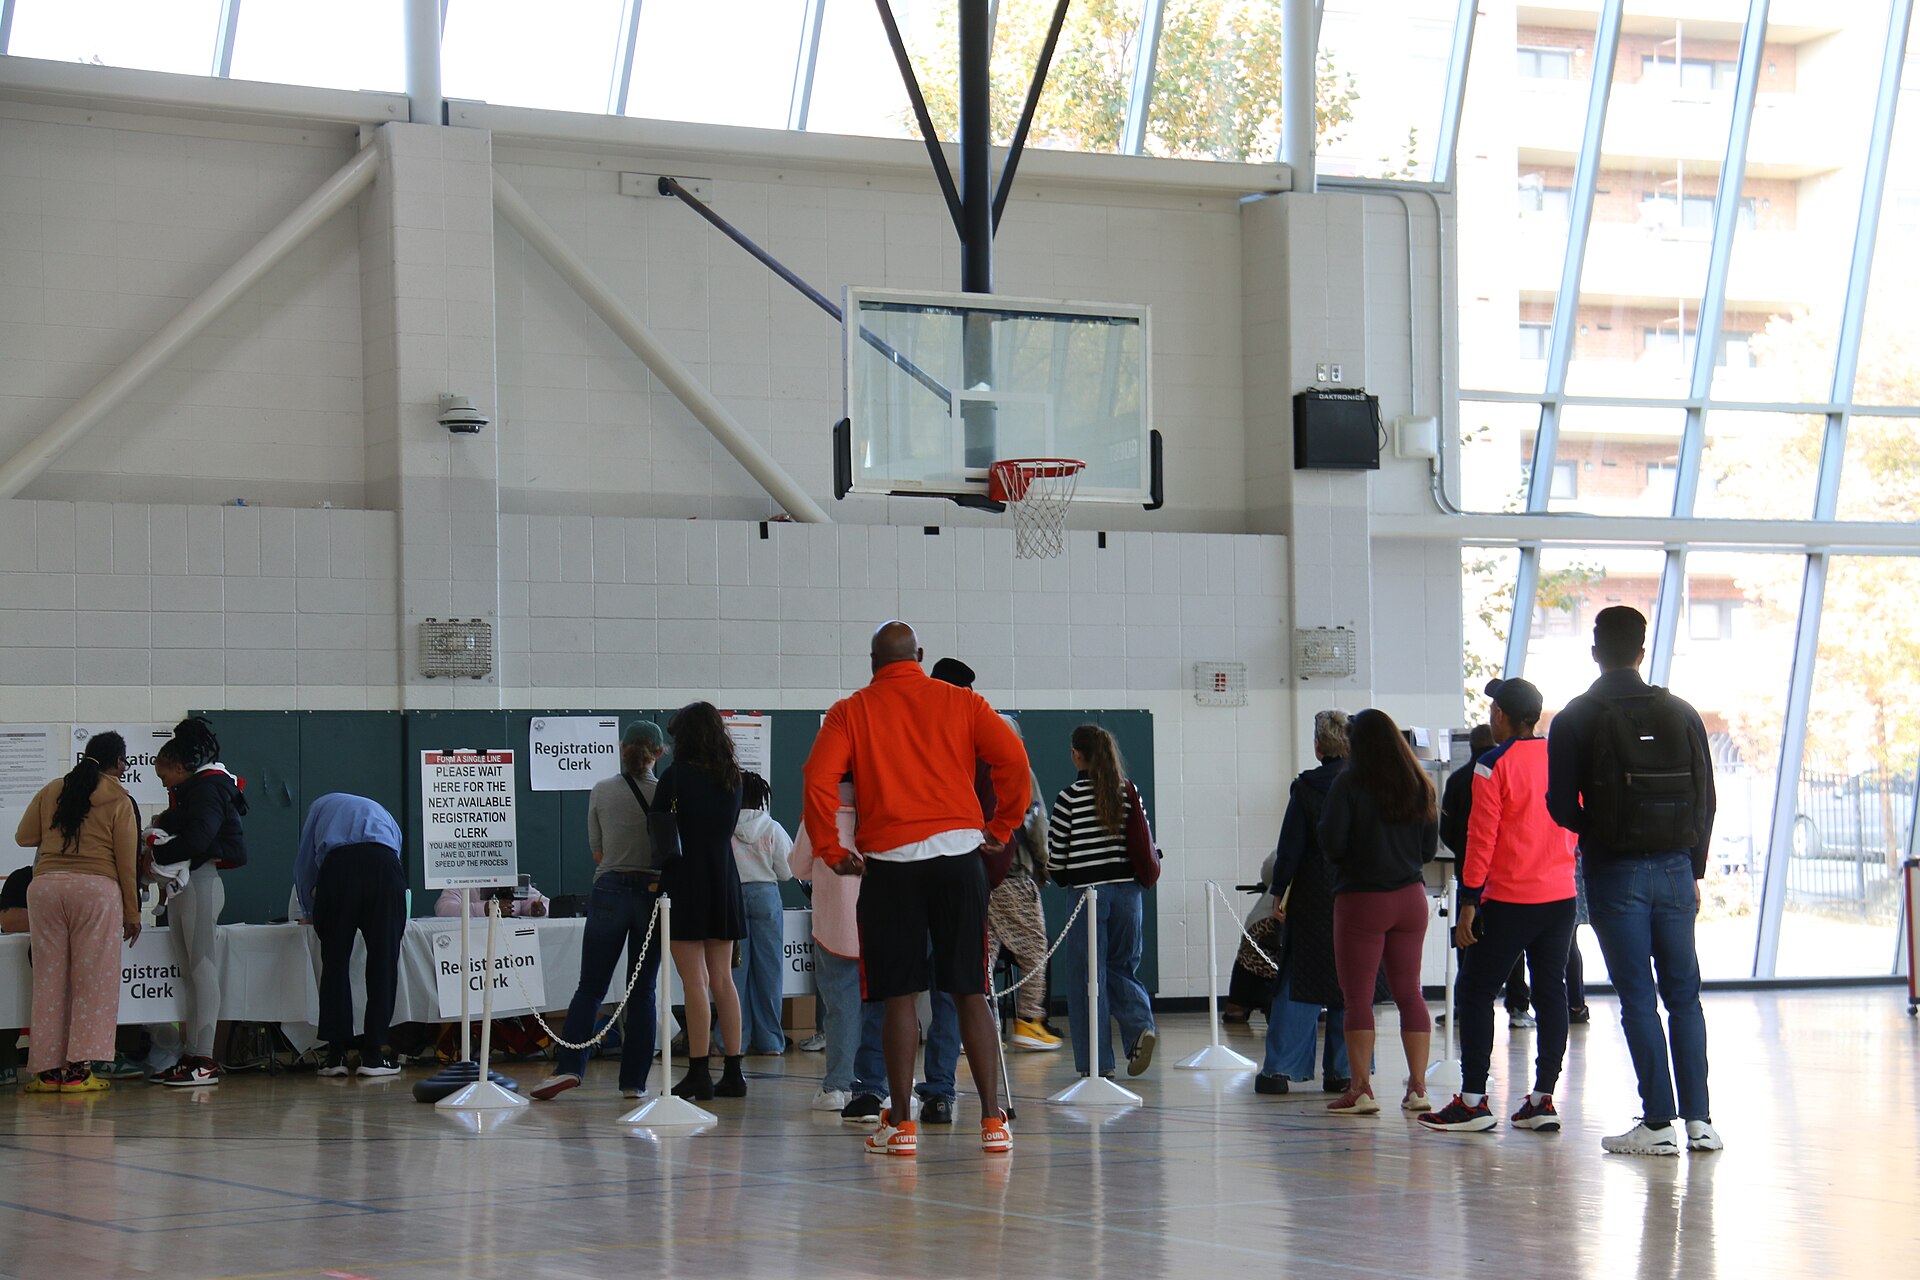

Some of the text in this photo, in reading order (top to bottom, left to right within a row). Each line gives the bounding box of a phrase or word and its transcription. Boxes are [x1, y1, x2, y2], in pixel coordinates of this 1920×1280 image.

[1318, 393, 1366, 401] DAKTRONICS
[535, 741, 614, 758] Registration
[456, 755, 462, 763] A
[462, 755, 486, 763] SINGLE
[486, 755, 501, 763] LINE
[558, 757, 592, 771] Clerk
[119, 769, 142, 783] erk
[436, 766, 503, 777] PLEASE WAIT
[433, 781, 506, 792] HERE FOR THE
[428, 796, 511, 808] NEXT AVAILABLE
[432, 812, 506, 823] REGISTRATION
[454, 827, 488, 838] CLERK
[444, 841, 456, 849] ARE
[458, 841, 471, 850] NOT
[472, 841, 503, 849] REQUIRED
[504, 840, 512, 848] TO
[467, 850, 479, 858] BUT
[435, 860, 456, 868] SPEED
[466, 859, 478, 867] THE
[479, 858, 508, 866] PROCESS
[441, 954, 535, 975] Reistation
[122, 963, 181, 983] gistrati
[469, 973, 509, 991] Clrk
[130, 982, 174, 999] Clerk
